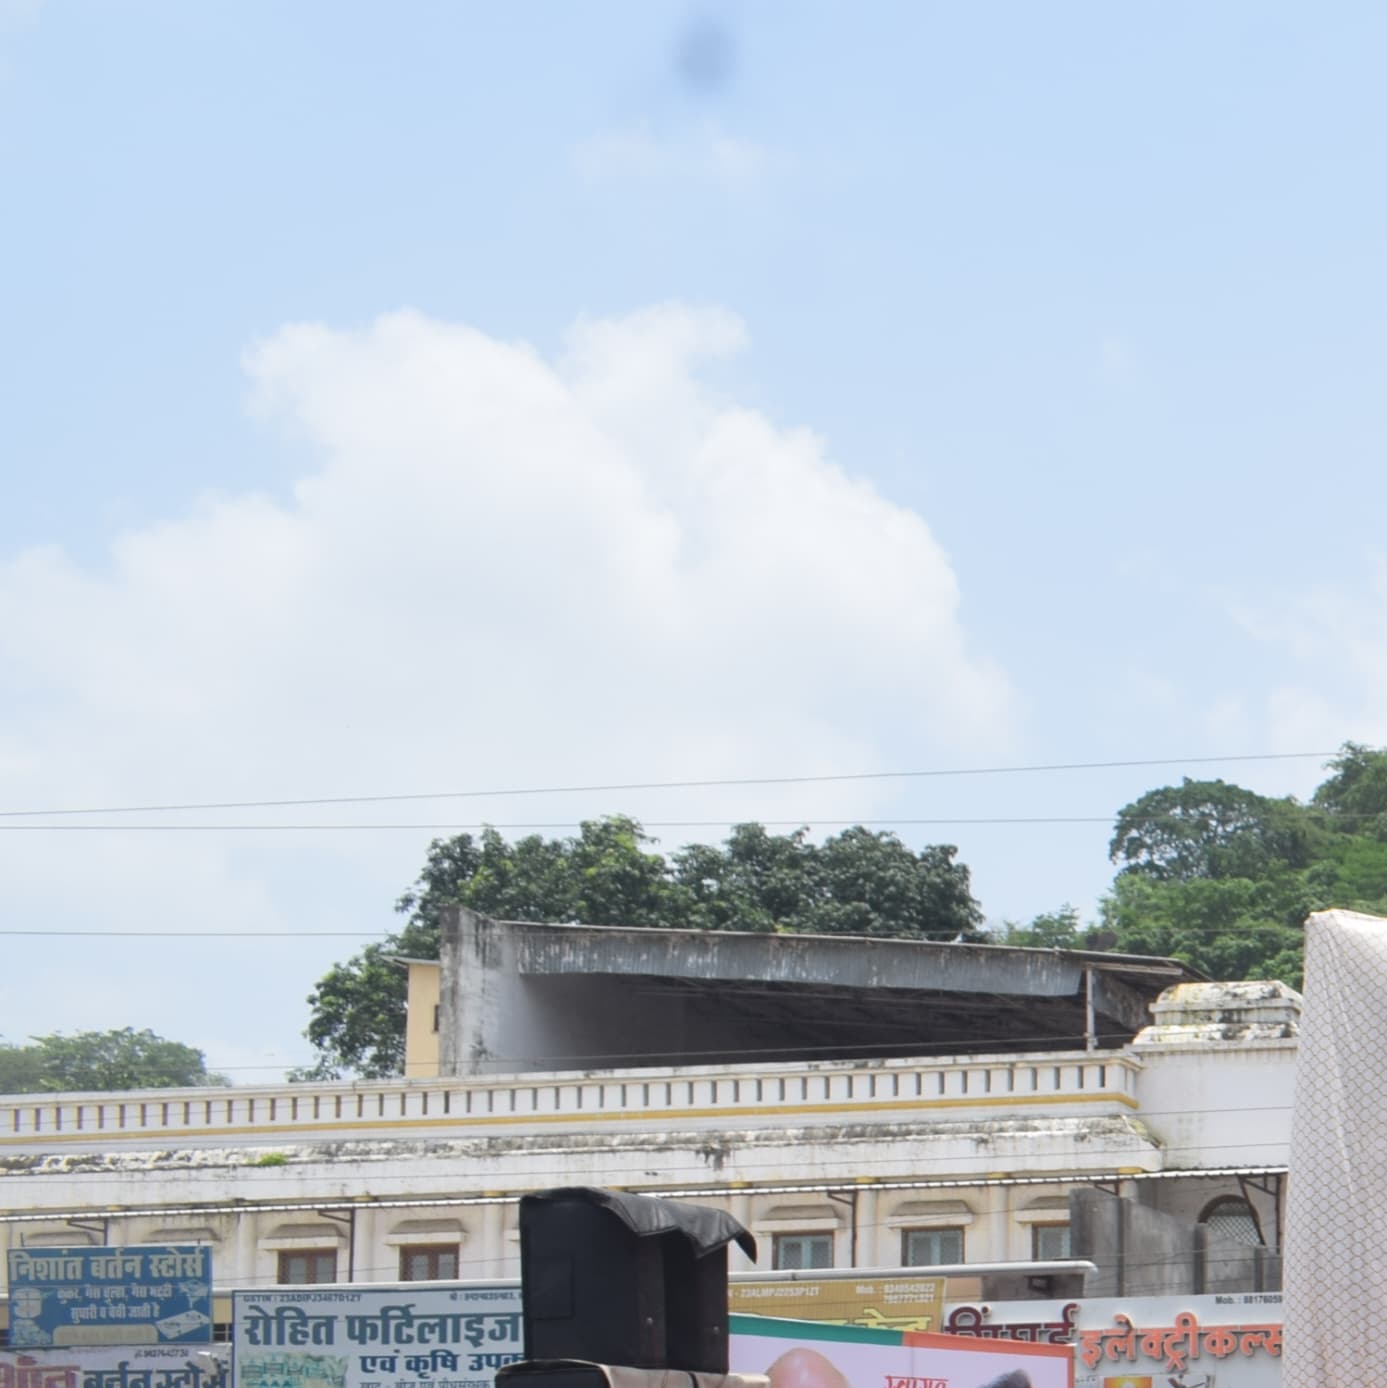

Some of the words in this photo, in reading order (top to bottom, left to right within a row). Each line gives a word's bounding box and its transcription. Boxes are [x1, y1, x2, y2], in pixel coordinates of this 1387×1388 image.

[8, 1249, 84, 1281] निशांत
[90, 1248, 143, 1279] बर्तन
[243, 1304, 339, 1345] रोहित
[345, 1303, 523, 1348] फर्टिलाइज
[1080, 1311, 1283, 1371] इलेक्ट्रीकल्स
[359, 1349, 399, 1373] एवं
[404, 1349, 461, 1379] कृषि
[467, 1352, 524, 1371] उपक
